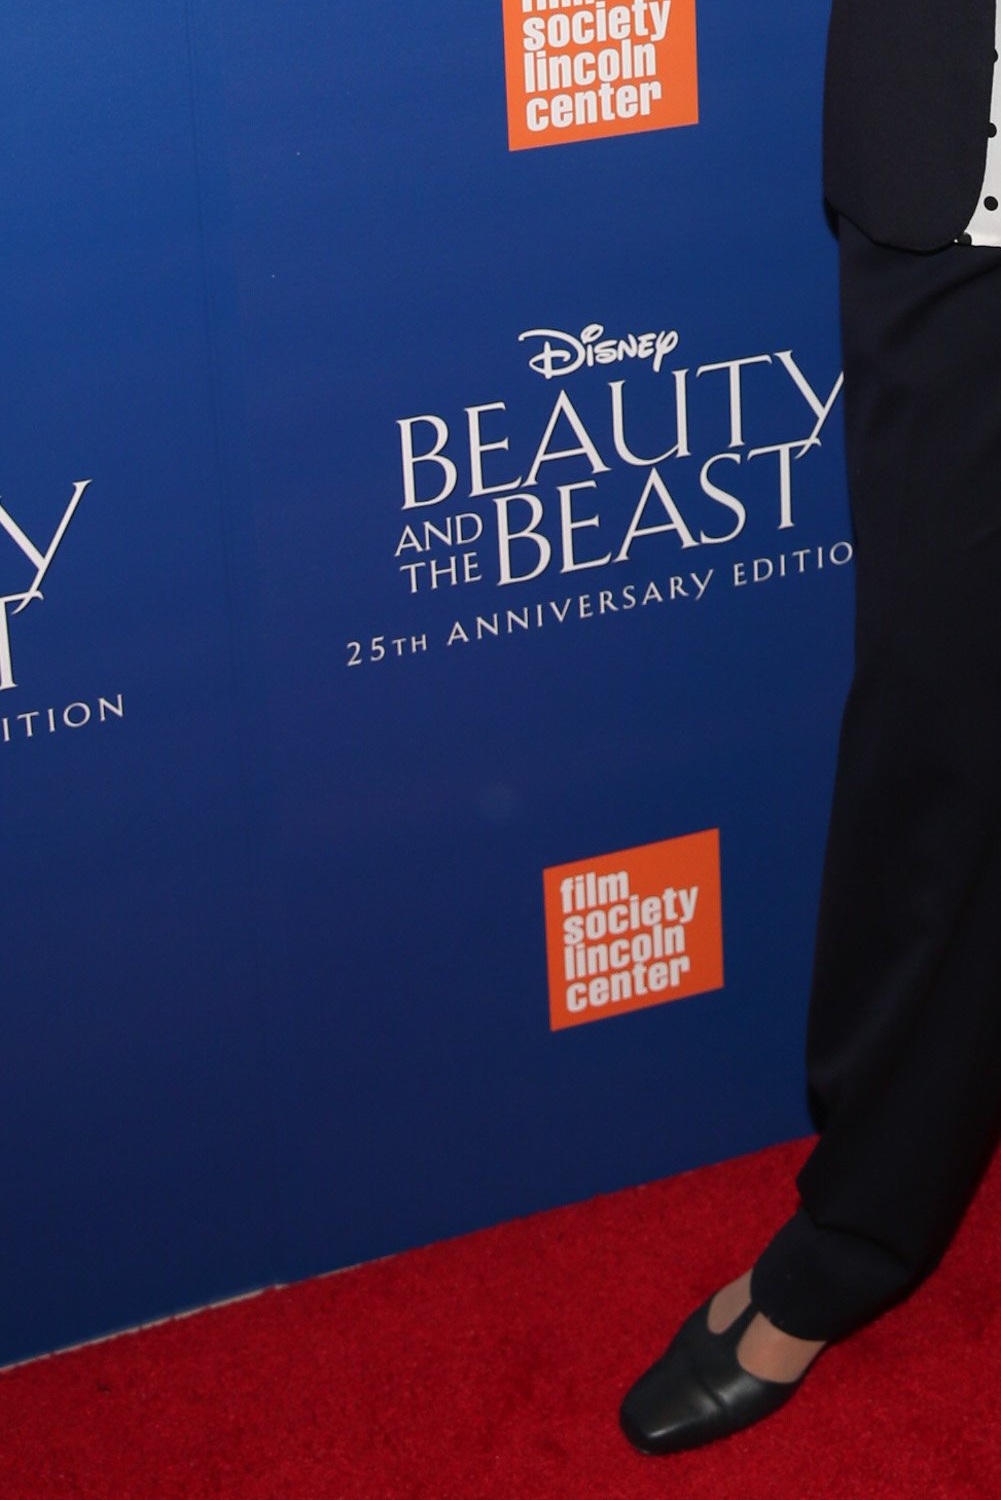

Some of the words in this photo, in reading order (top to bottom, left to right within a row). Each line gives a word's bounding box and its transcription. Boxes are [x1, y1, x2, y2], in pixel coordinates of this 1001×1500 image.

[523, 38, 657, 94] lincoln
[526, 81, 662, 132] center
[518, 323, 679, 379] Disney
[396, 349, 845, 512] BEAUTY
[393, 512, 484, 557] AND
[493, 436, 822, 588] BEAST
[399, 552, 483, 595] THE
[345, 634, 428, 668] 25TH
[446, 568, 715, 647] ANNIVERSARY
[732, 540, 854, 587] EDITIO
[560, 870, 629, 914] film
[563, 885, 699, 945] society
[564, 922, 686, 981] lincoln
[566, 955, 691, 1013] center
